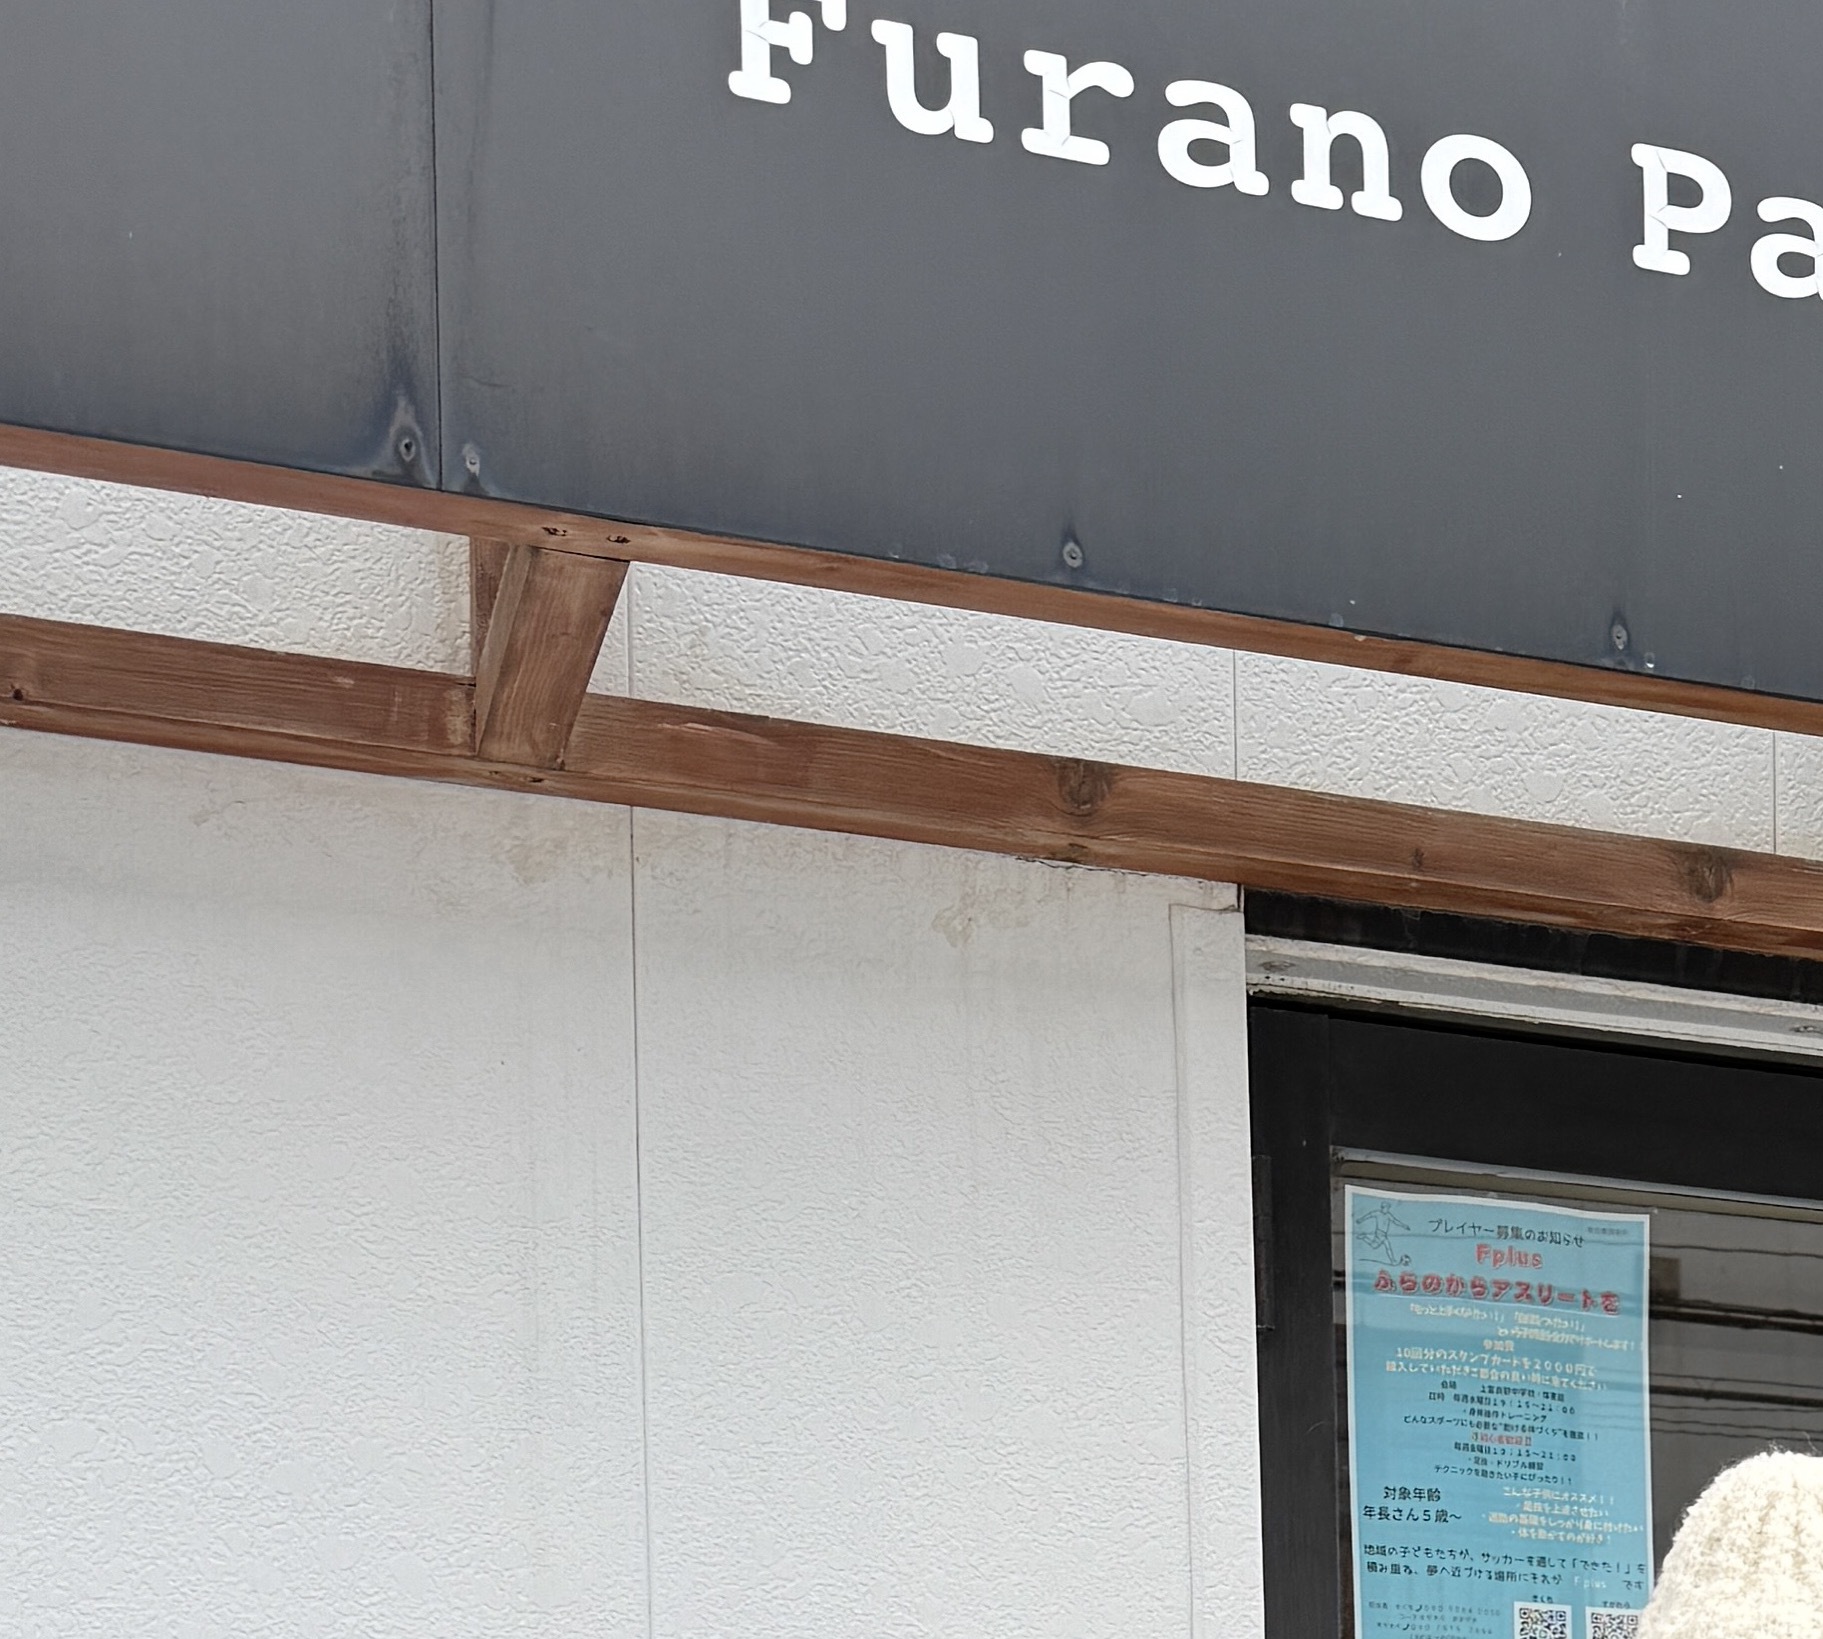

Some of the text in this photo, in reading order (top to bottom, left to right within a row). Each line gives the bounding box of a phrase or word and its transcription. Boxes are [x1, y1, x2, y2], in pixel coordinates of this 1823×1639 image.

[727, 0, 1533, 242] Furano
[1428, 1219, 1585, 1248] プレイヤー募集のお知らせ
[1475, 1243, 1543, 1270] Fplus
[1373, 1269, 1621, 1315] ふらのからアスリートを
[1383, 1486, 1441, 1503] 対象年齢
